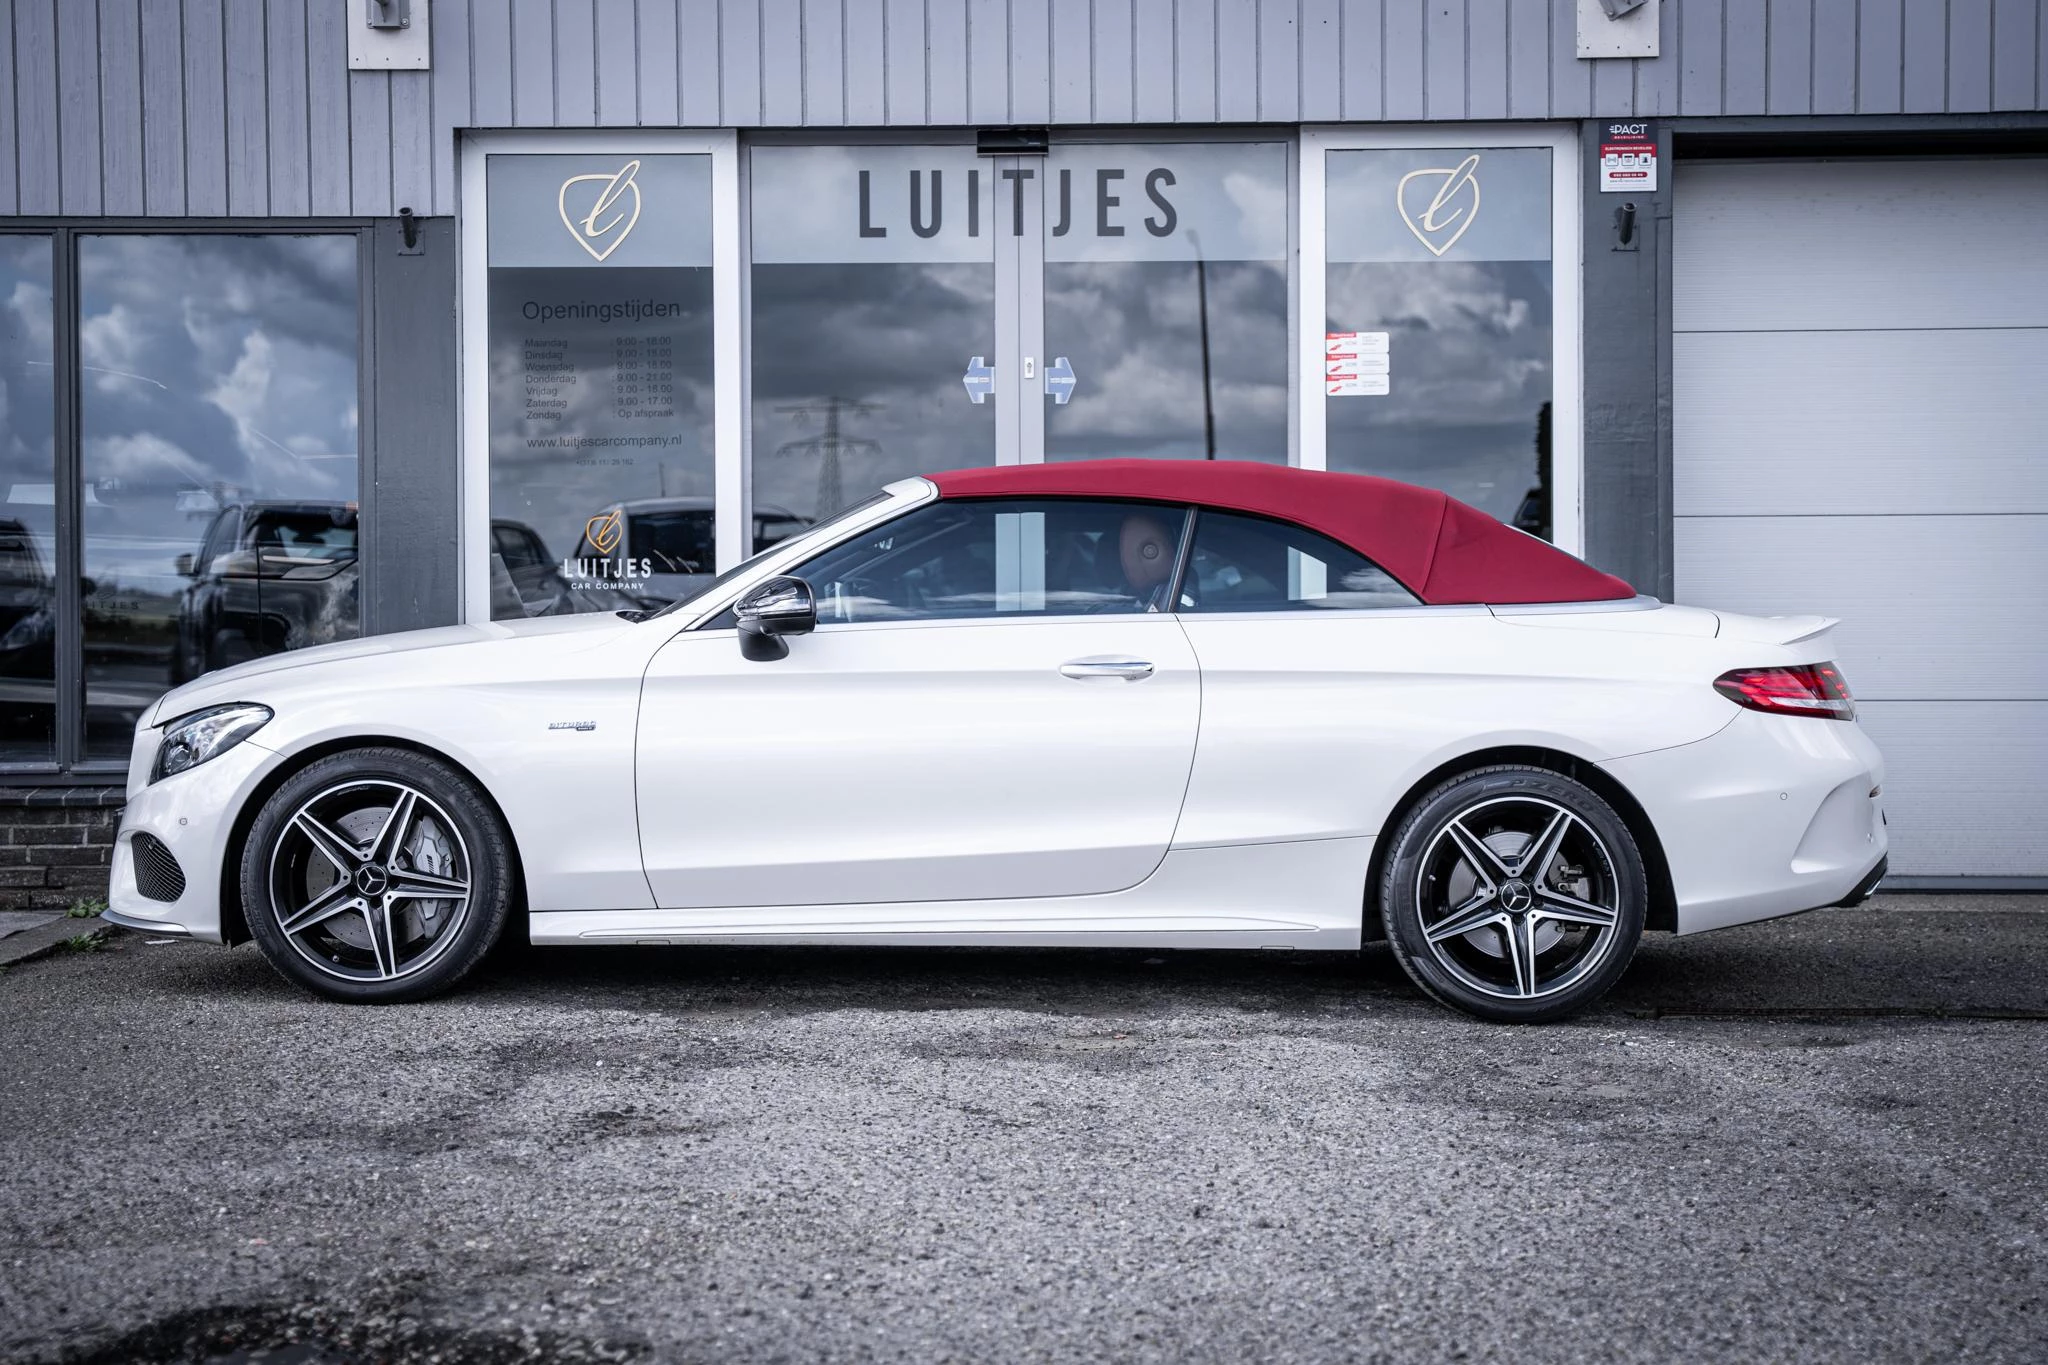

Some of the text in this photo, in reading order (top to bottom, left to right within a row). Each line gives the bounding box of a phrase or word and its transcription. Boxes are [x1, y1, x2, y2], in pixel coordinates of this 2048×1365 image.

[1611, 123, 1648, 134] PACT
[858, 167, 1178, 238] LUITJES
[522, 297, 681, 323] Openingstijden
[525, 339, 568, 350] Maandag
[525, 351, 563, 362] Dinsdag
[525, 363, 575, 373] Woensdag
[526, 374, 577, 385] Donderdag
[526, 387, 558, 397] Vrijdag
[527, 398, 568, 409] Zaterdag
[527, 409, 674, 421] Zondag Op afspraak
[526, 433, 683, 450] www.luitjescarcompany.nl
[563, 557, 652, 579] LUITJES
[571, 582, 645, 590] CAR COMPANY
